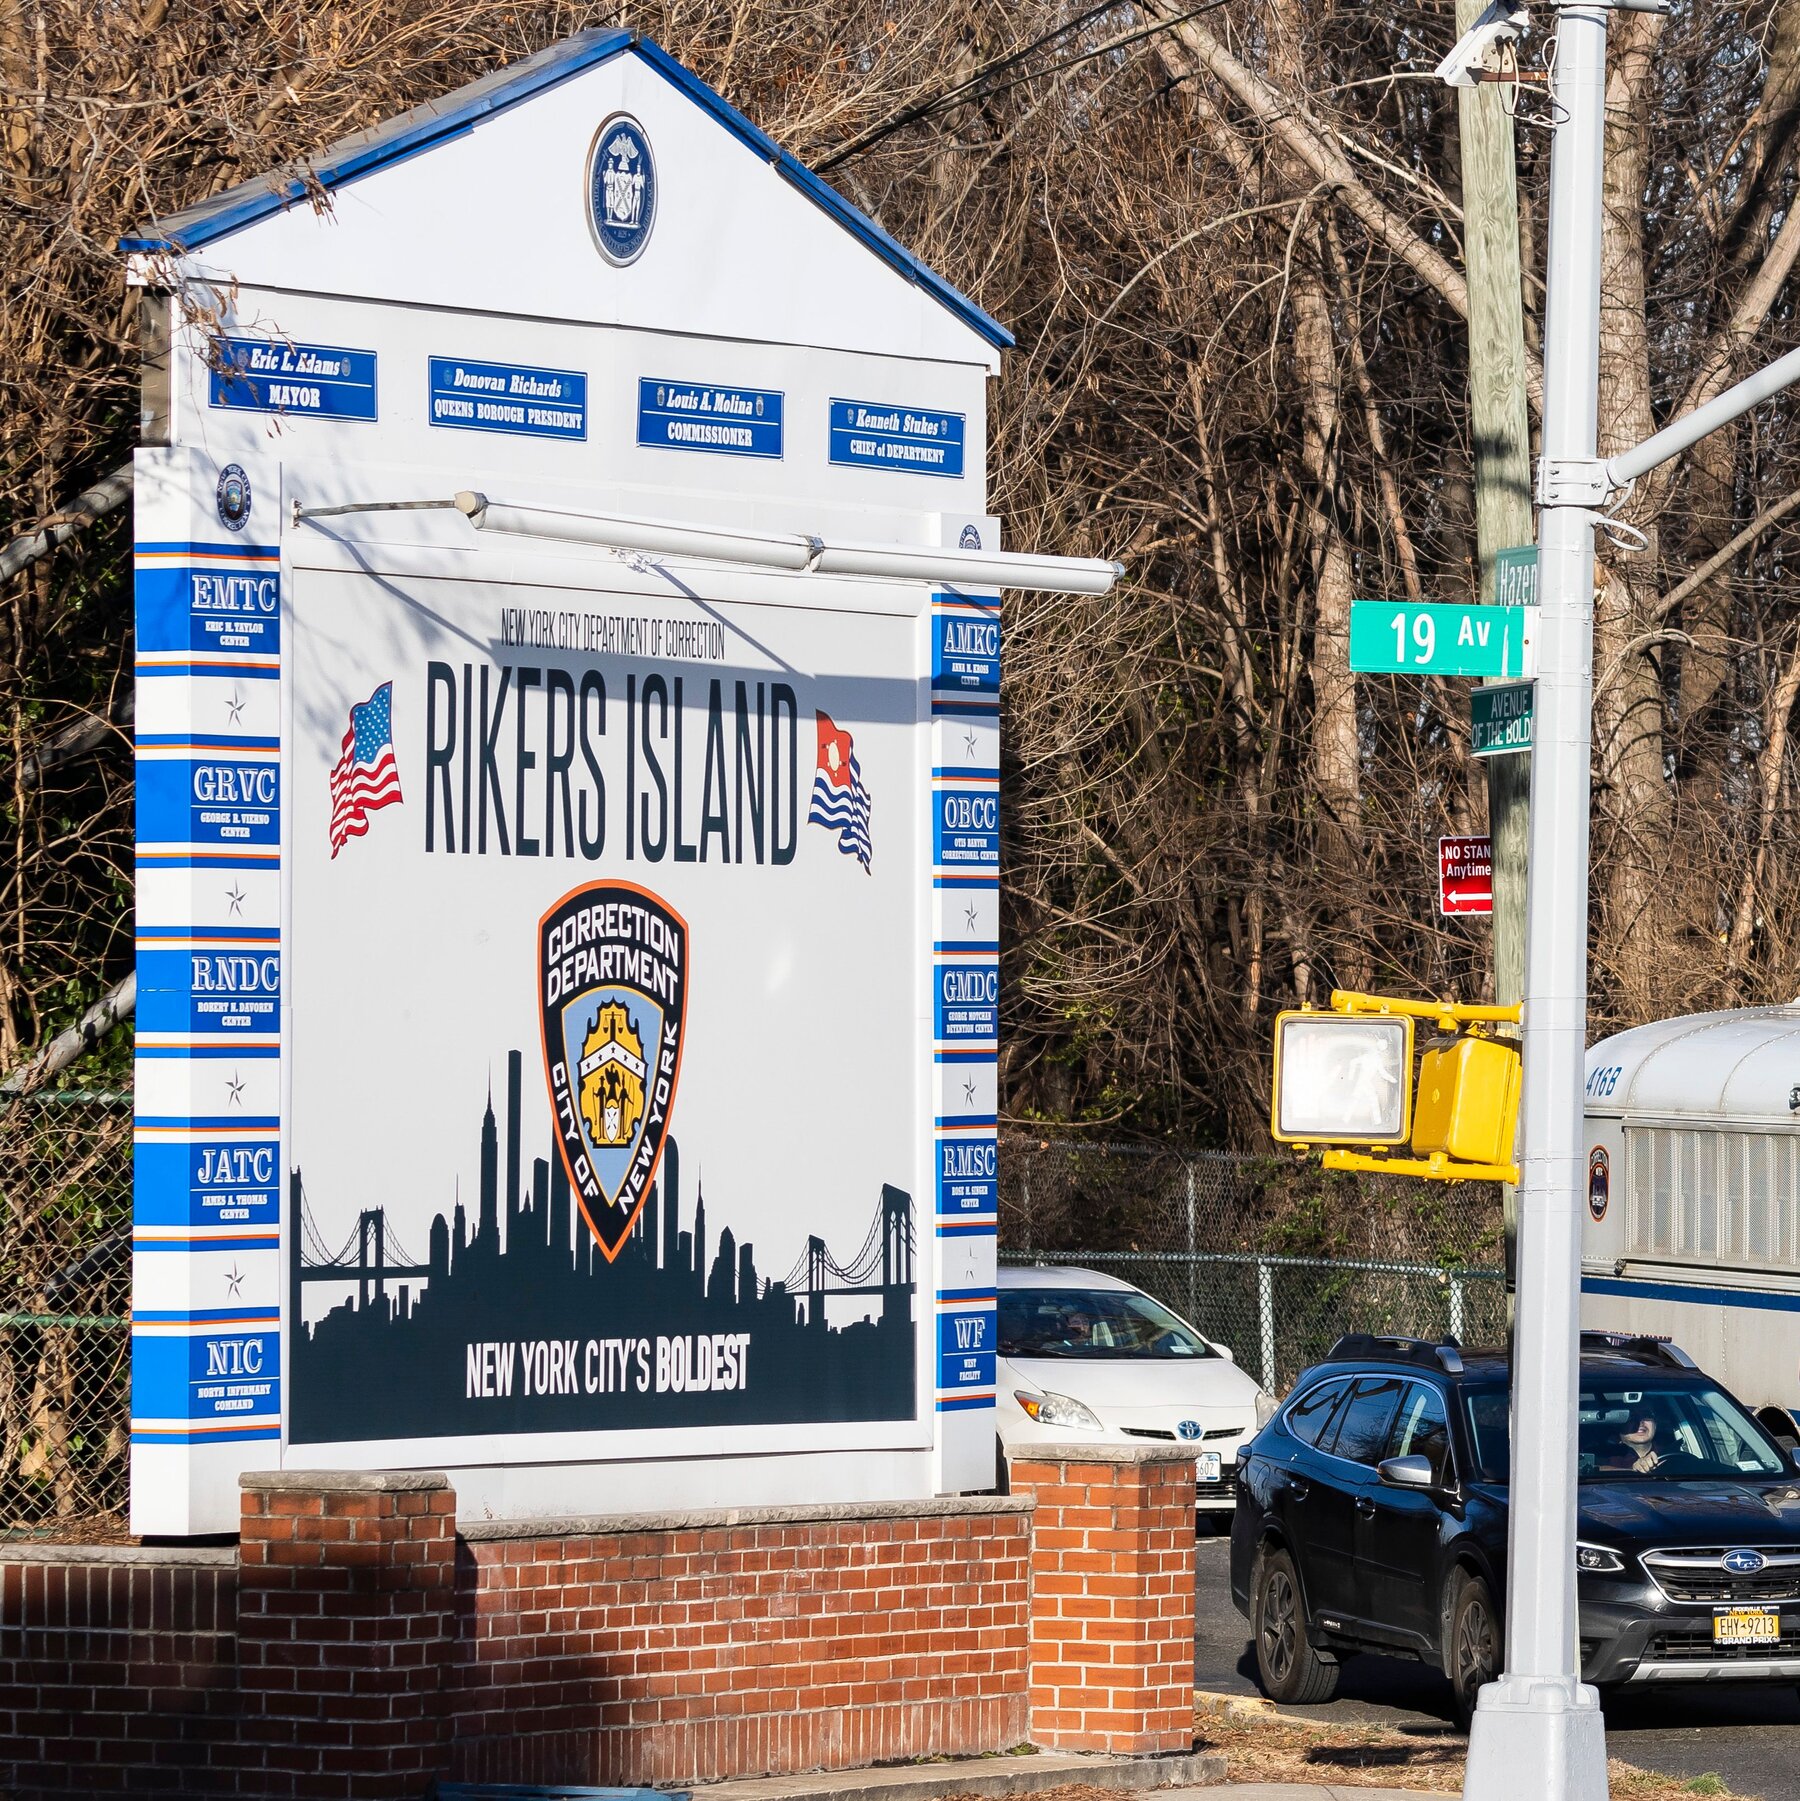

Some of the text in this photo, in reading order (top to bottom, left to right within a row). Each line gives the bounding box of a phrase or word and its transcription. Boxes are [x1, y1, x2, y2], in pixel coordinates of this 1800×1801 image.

[251, 348, 340, 376] Eric L. Adams
[269, 384, 320, 408] MAYOR
[454, 368, 562, 397] Donovan Richards
[434, 398, 583, 429] QUEENS BOROUGH PRESIDENT
[666, 388, 753, 415] Louis A. Molina
[667, 422, 753, 447] COMMISSIONER
[856, 409, 939, 435] Kenneth Stukes
[850, 439, 944, 464] CHIEF of DEPARTMENT
[191, 574, 277, 612] EMTC
[1500, 559, 1537, 606] Hazen
[501, 607, 725, 660] NEW YORK CITY DEPARTMENT OF CORRECTION
[944, 622, 997, 656] AMKC
[1390, 613, 1491, 664] 19 Av
[1490, 690, 1529, 719] AVENUE
[1471, 717, 1533, 748] OF THE BOLD
[425, 660, 798, 866] RIKERS ISLAND
[193, 765, 276, 803] GRVC
[944, 796, 996, 829] OBCC
[1445, 846, 1461, 860] NO
[1446, 862, 1492, 880] Anytime
[548, 903, 679, 968] CORRECTION
[191, 956, 279, 992] RNDC
[547, 944, 678, 1007] DEPARTMENT
[943, 970, 997, 1003] GMDC
[1586, 1066, 1622, 1096] 416B
[552, 1061, 600, 1198] CITY OF
[618, 1020, 678, 1215] NEW YORK
[197, 1147, 273, 1184] JATC
[943, 1145, 996, 1177] RMSC
[954, 1317, 986, 1349] WF
[206, 1339, 263, 1376] NIC
[466, 1333, 750, 1398] NEW YORK CITY'S BOLDEST
[1720, 1616, 1774, 1636] EHY 9213
[1722, 1636, 1773, 1645] GRAND PRIX
